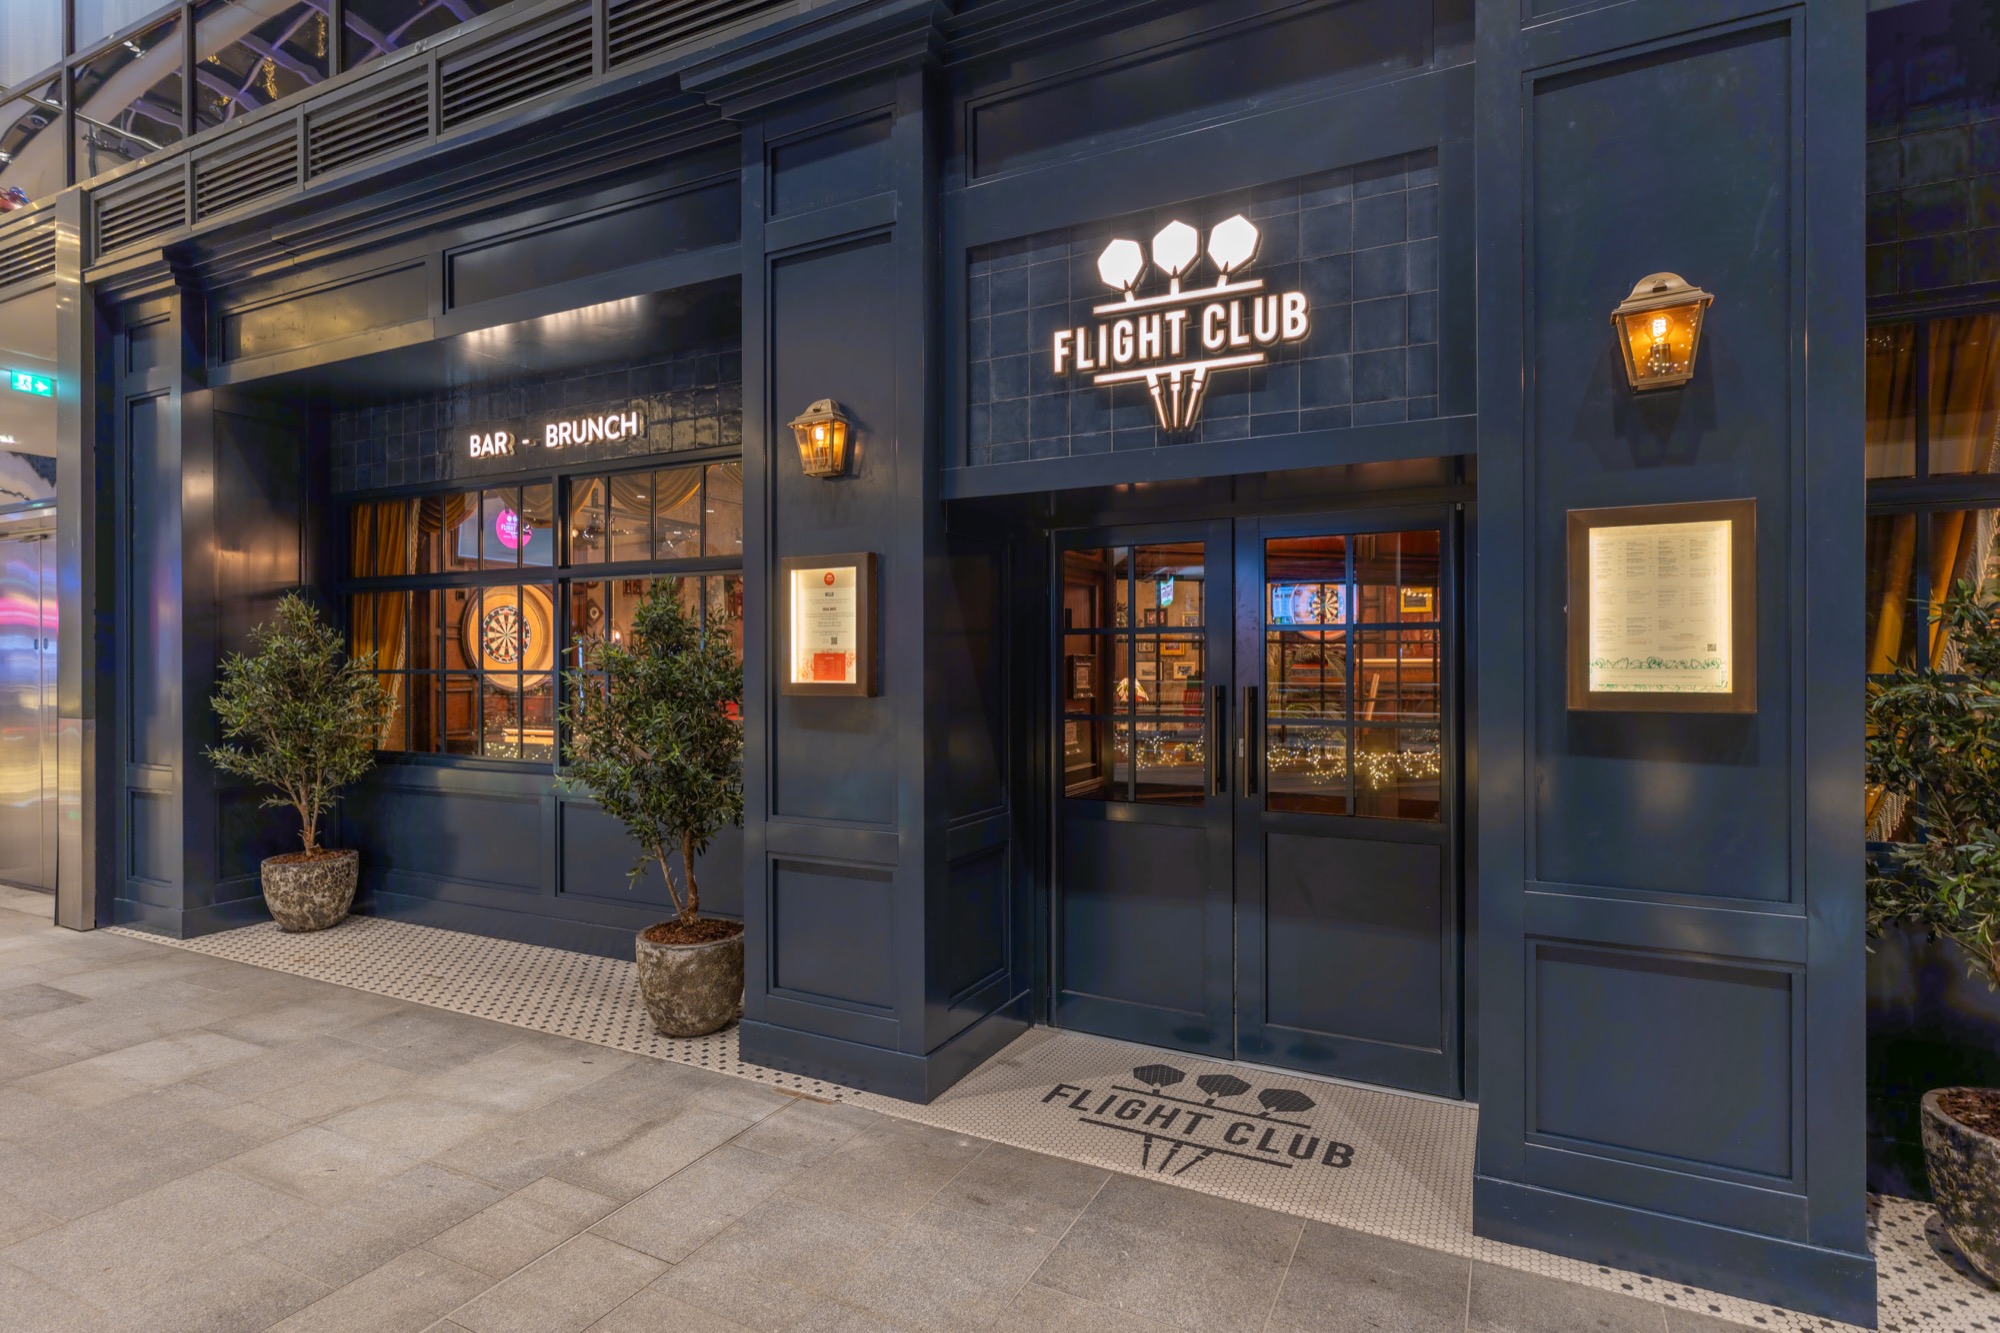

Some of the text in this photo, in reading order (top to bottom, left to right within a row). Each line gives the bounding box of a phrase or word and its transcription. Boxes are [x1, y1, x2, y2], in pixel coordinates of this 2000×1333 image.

[1053, 291, 1309, 374] FLIGHT CLUB
[470, 431, 508, 458] BAR
[545, 411, 638, 448] BRUNCH
[1041, 1083, 1355, 1169] FLIGHT CLUB
